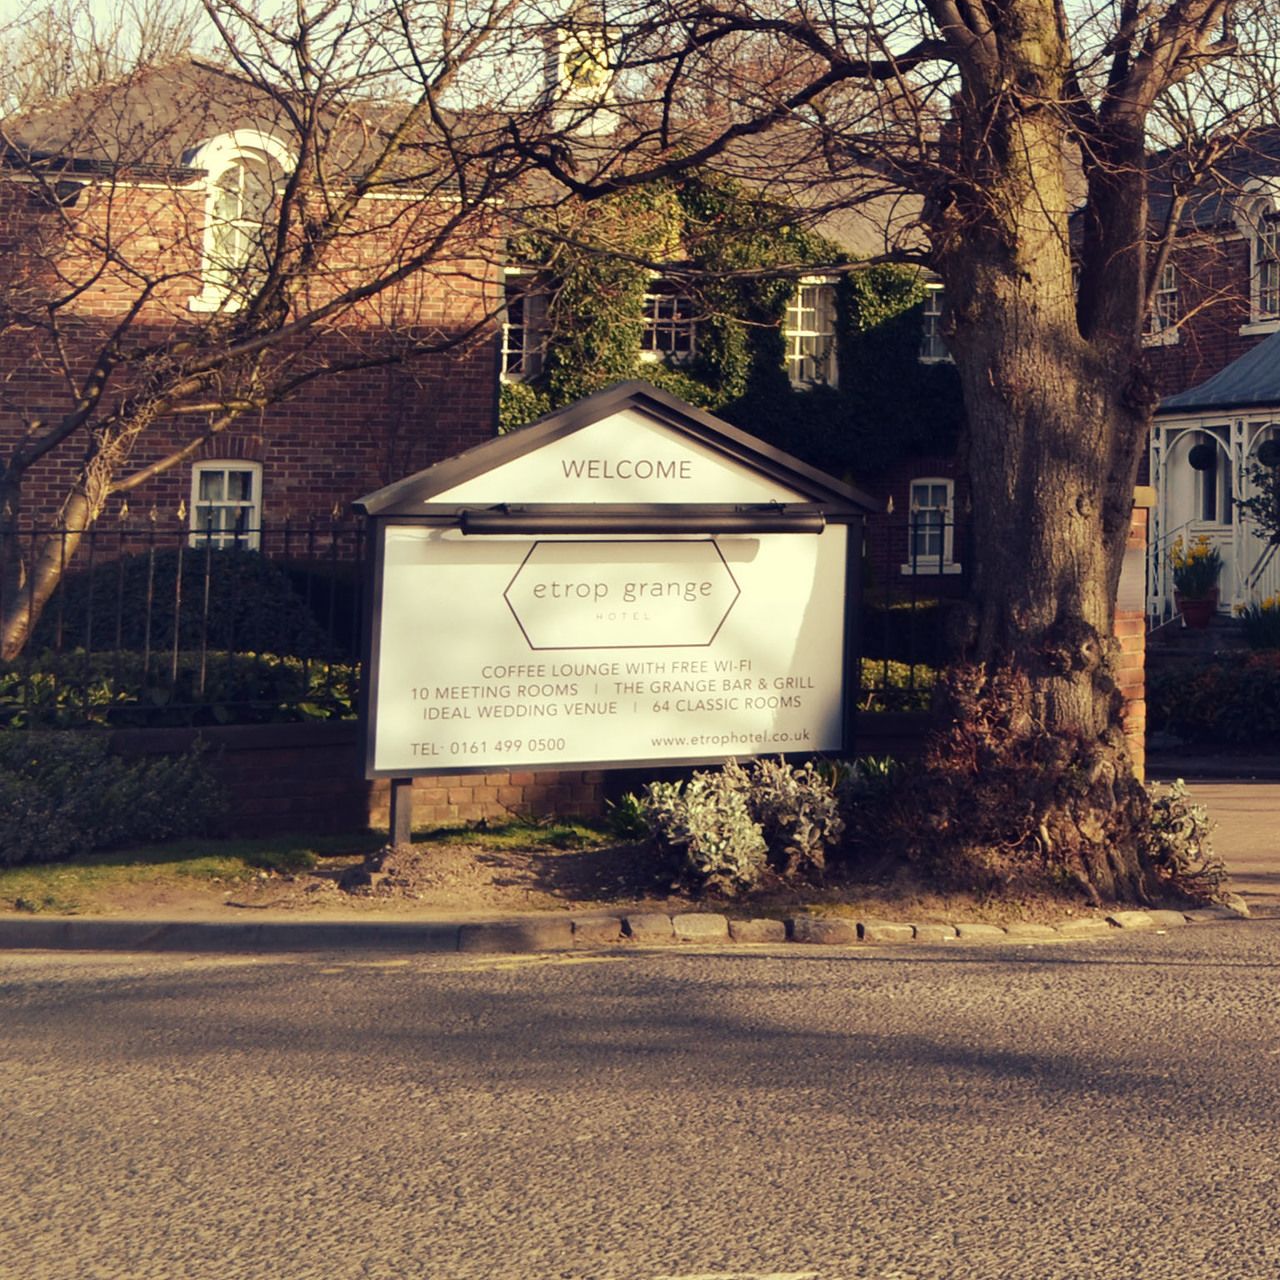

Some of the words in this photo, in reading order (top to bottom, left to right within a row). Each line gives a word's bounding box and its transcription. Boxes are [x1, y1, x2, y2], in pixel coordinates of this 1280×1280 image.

[562, 460, 692, 479] WELCOME
[533, 581, 609, 603] etrop
[622, 581, 713, 603] grange
[596, 611, 650, 621] HOTEL
[482, 664, 545, 679] COFFEE
[552, 663, 619, 677] LOUNGE
[626, 662, 665, 675] WITH
[672, 661, 707, 673] FREE
[715, 660, 751, 672] WI-FI
[411, 688, 429, 700] 10
[435, 685, 511, 700] MEETING
[518, 683, 578, 697] ROOMS
[615, 682, 644, 694] THE
[650, 680, 716, 693] GRANGE
[723, 679, 752, 691] BAR
[758, 678, 768, 690] &
[773, 676, 814, 689] GRILL
[423, 706, 471, 720] IDEAL
[478, 704, 558, 718] WEDDING
[564, 702, 617, 716] VENUE
[652, 700, 669, 713] 64
[676, 698, 739, 712] CLASSIC
[745, 696, 801, 709] ROOMS
[450, 741, 487, 754] 0161
[495, 739, 522, 752] 499
[528, 738, 566, 752] 0500
[651, 729, 810, 746] www.etrophotel.co.uk
